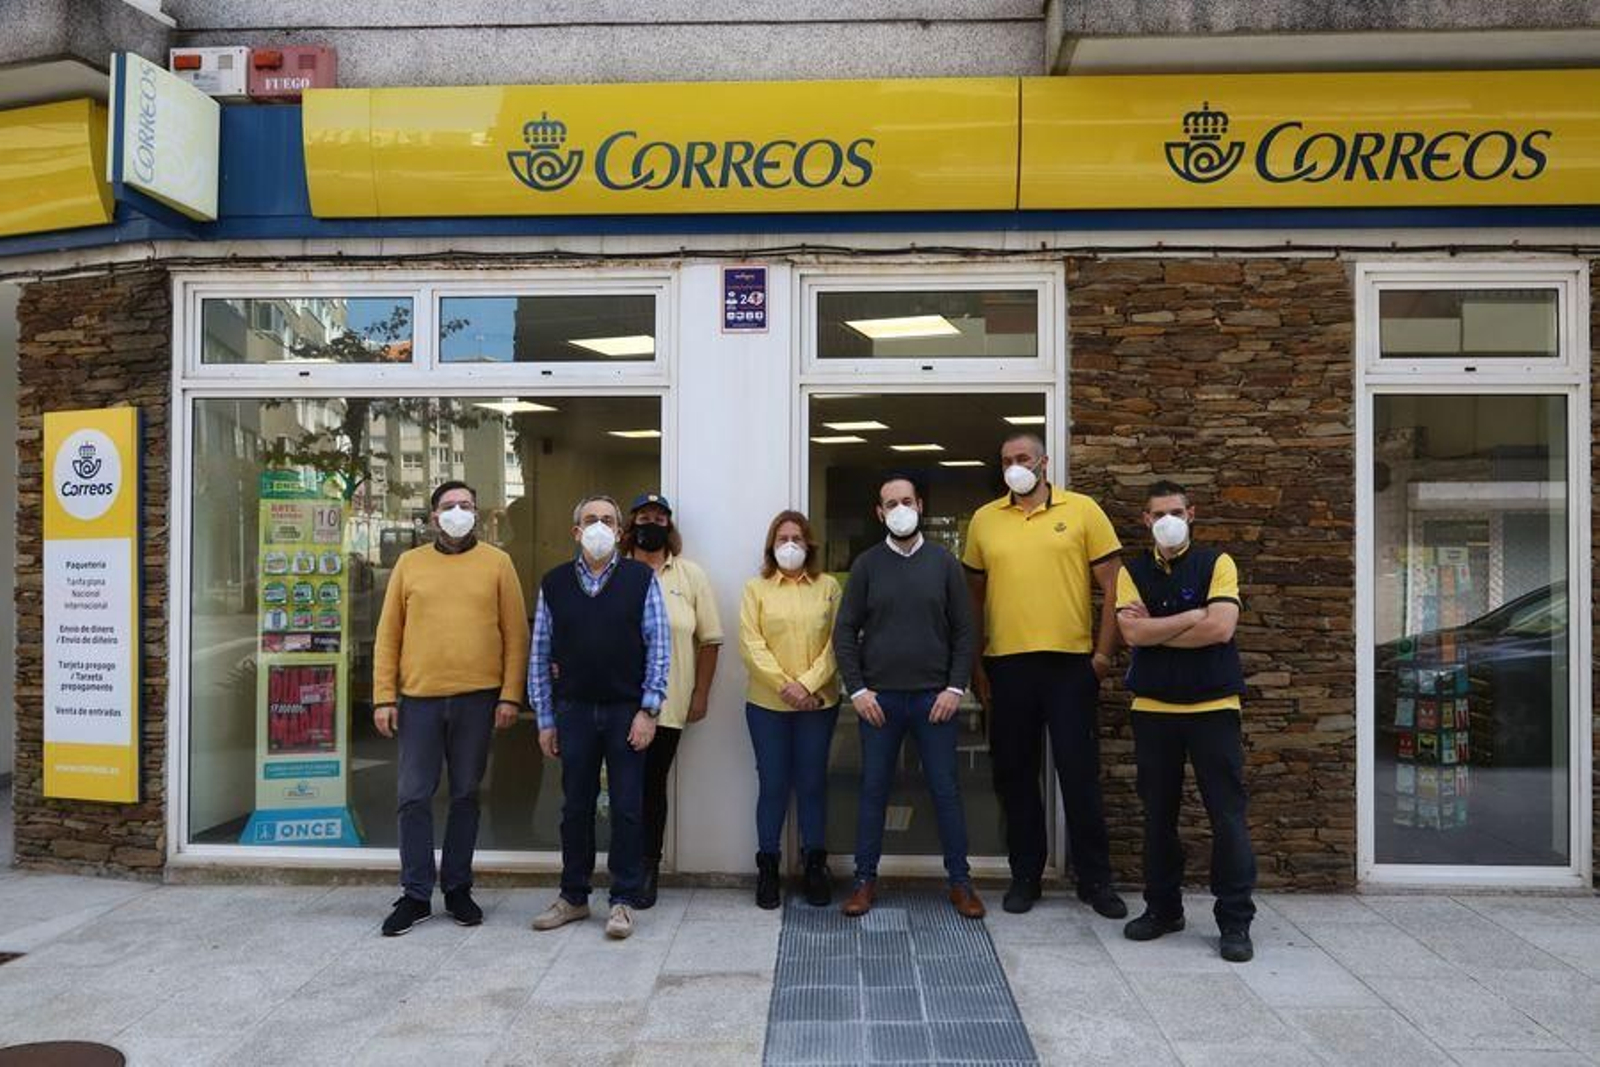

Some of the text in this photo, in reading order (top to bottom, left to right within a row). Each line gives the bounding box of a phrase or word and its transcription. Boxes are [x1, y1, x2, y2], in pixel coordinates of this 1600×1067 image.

[264, 77, 311, 91] FUEGO
[132, 61, 158, 185] CORREOS
[594, 130, 876, 191] CORREOS
[1254, 121, 1553, 184] CORREOS
[60, 480, 114, 497] Correos
[317, 509, 338, 526] 10
[71, 590, 100, 598] Nacional
[81, 624, 90, 634] de
[91, 624, 114, 634] dinero
[58, 660, 116, 672] Tarjeta prepago
[55, 705, 122, 718] Venta de entradas
[280, 821, 337, 838] ONCE
